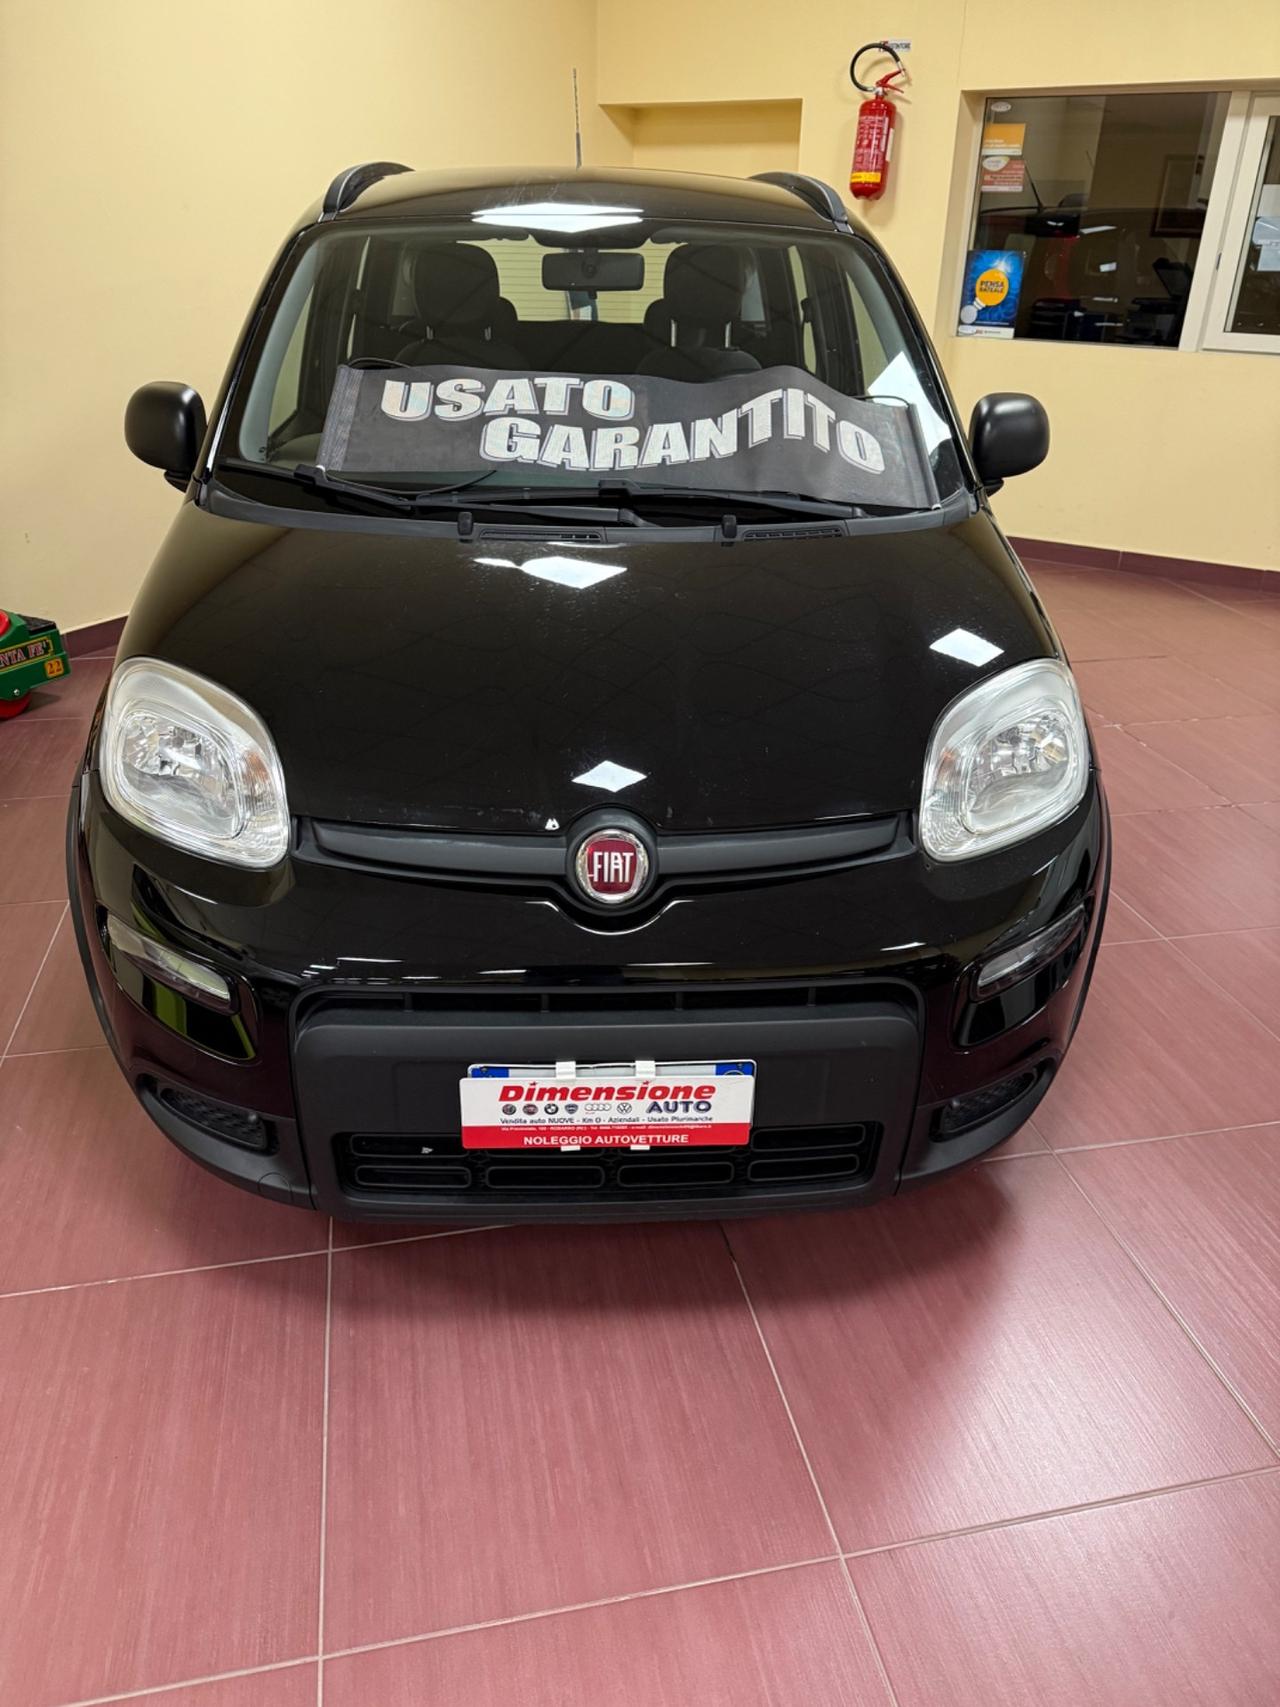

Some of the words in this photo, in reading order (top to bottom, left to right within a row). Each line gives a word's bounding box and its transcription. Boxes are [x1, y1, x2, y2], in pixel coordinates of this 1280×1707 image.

[381, 376, 635, 421] USATO
[479, 387, 885, 475] GARANTITO
[47, 660, 63, 675] 22
[593, 851, 634, 883] FIAT
[498, 1081, 716, 1102] Dimensione
[646, 1101, 712, 1114] AUTO
[500, 1117, 528, 1125] Vendita
[523, 1135, 592, 1145] NOLEGGIO
[595, 1134, 689, 1144] AUTOVETTURE
